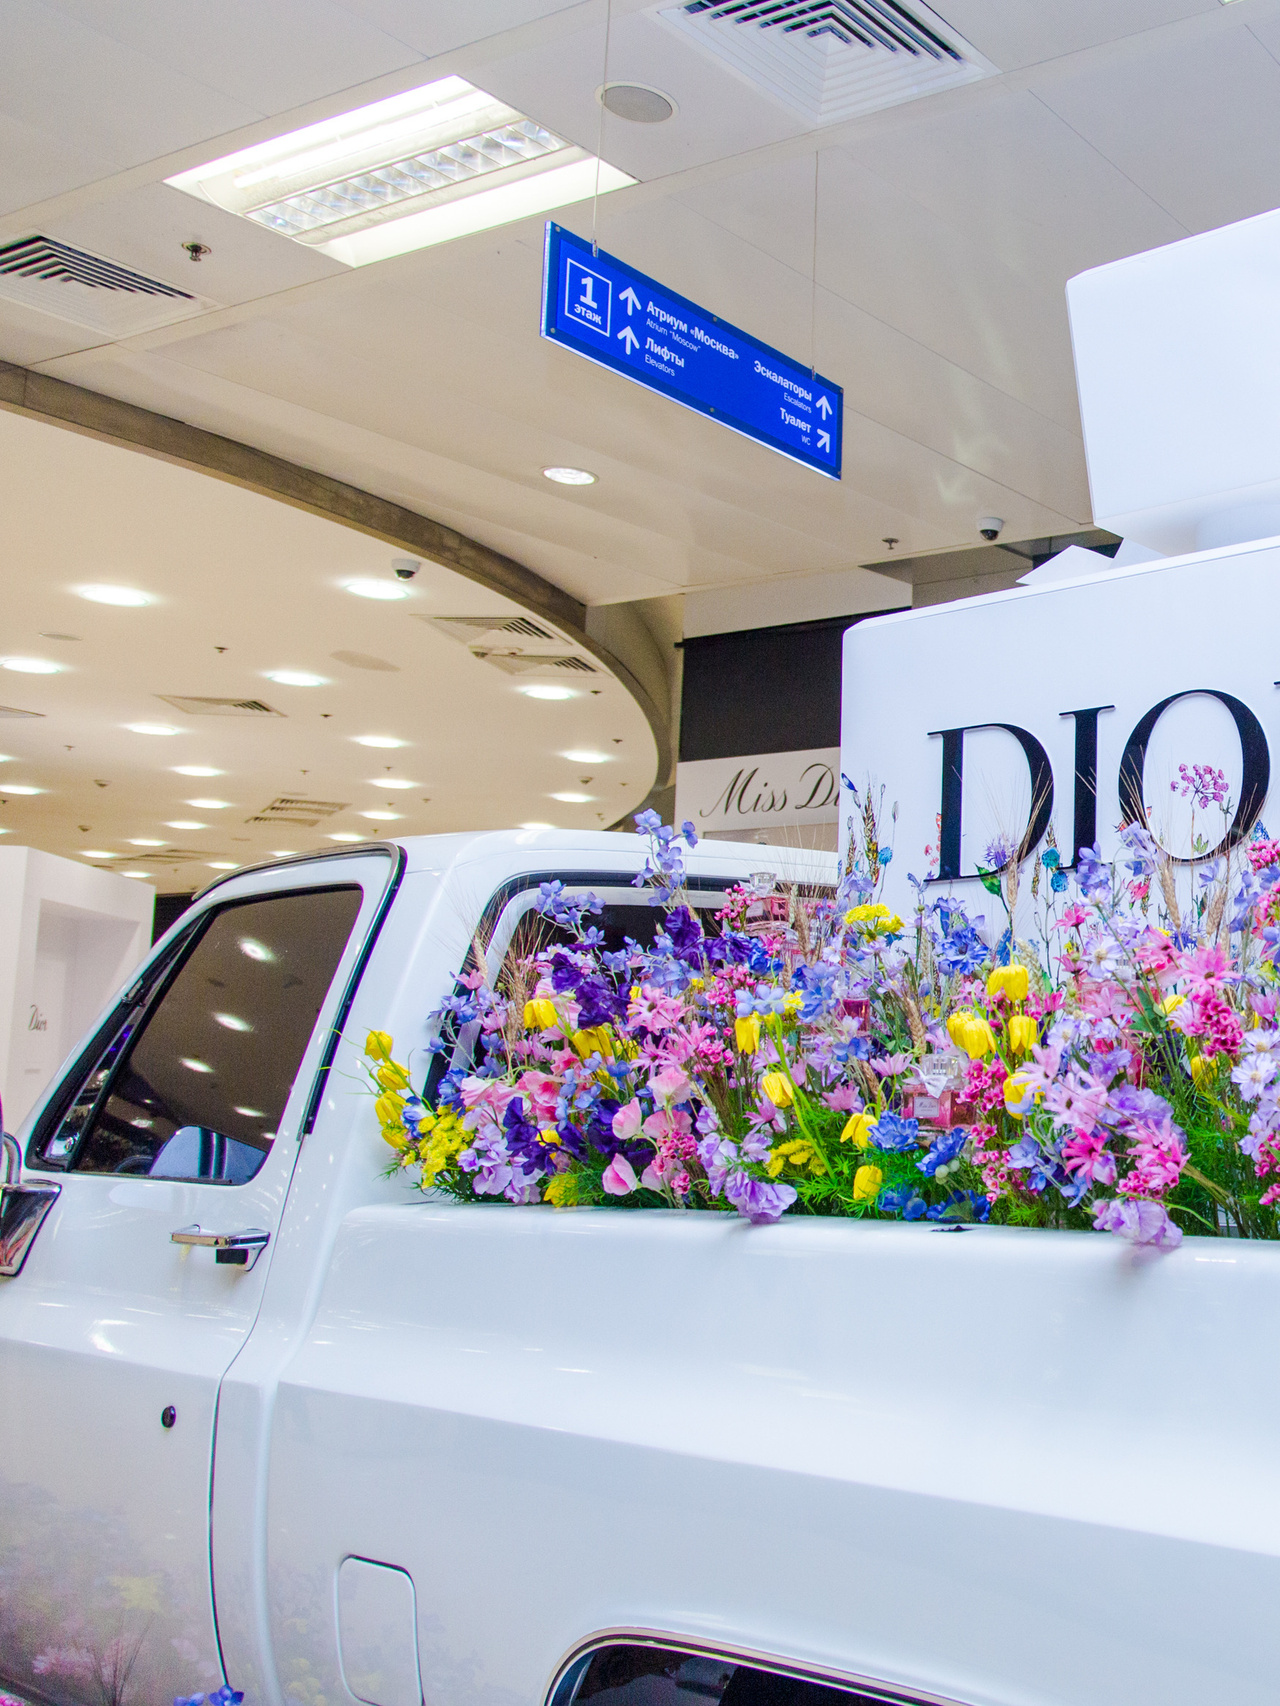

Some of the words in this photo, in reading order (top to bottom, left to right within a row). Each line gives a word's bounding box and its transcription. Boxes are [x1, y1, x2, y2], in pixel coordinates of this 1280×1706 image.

[579, 276, 598, 309] 1
[574, 303, 602, 325] этаж
[646, 317, 668, 336] Atrium
[646, 301, 688, 334] Атриум
[689, 326, 739, 360] «Москва»
[644, 355, 675, 376] Elevators
[645, 337, 685, 368] Лифты
[753, 360, 812, 402] Эскалаторы
[783, 393, 812, 414] Escalators
[779, 407, 812, 434] Туалет
[801, 435, 811, 446] WC
[699, 767, 788, 818] Miss
